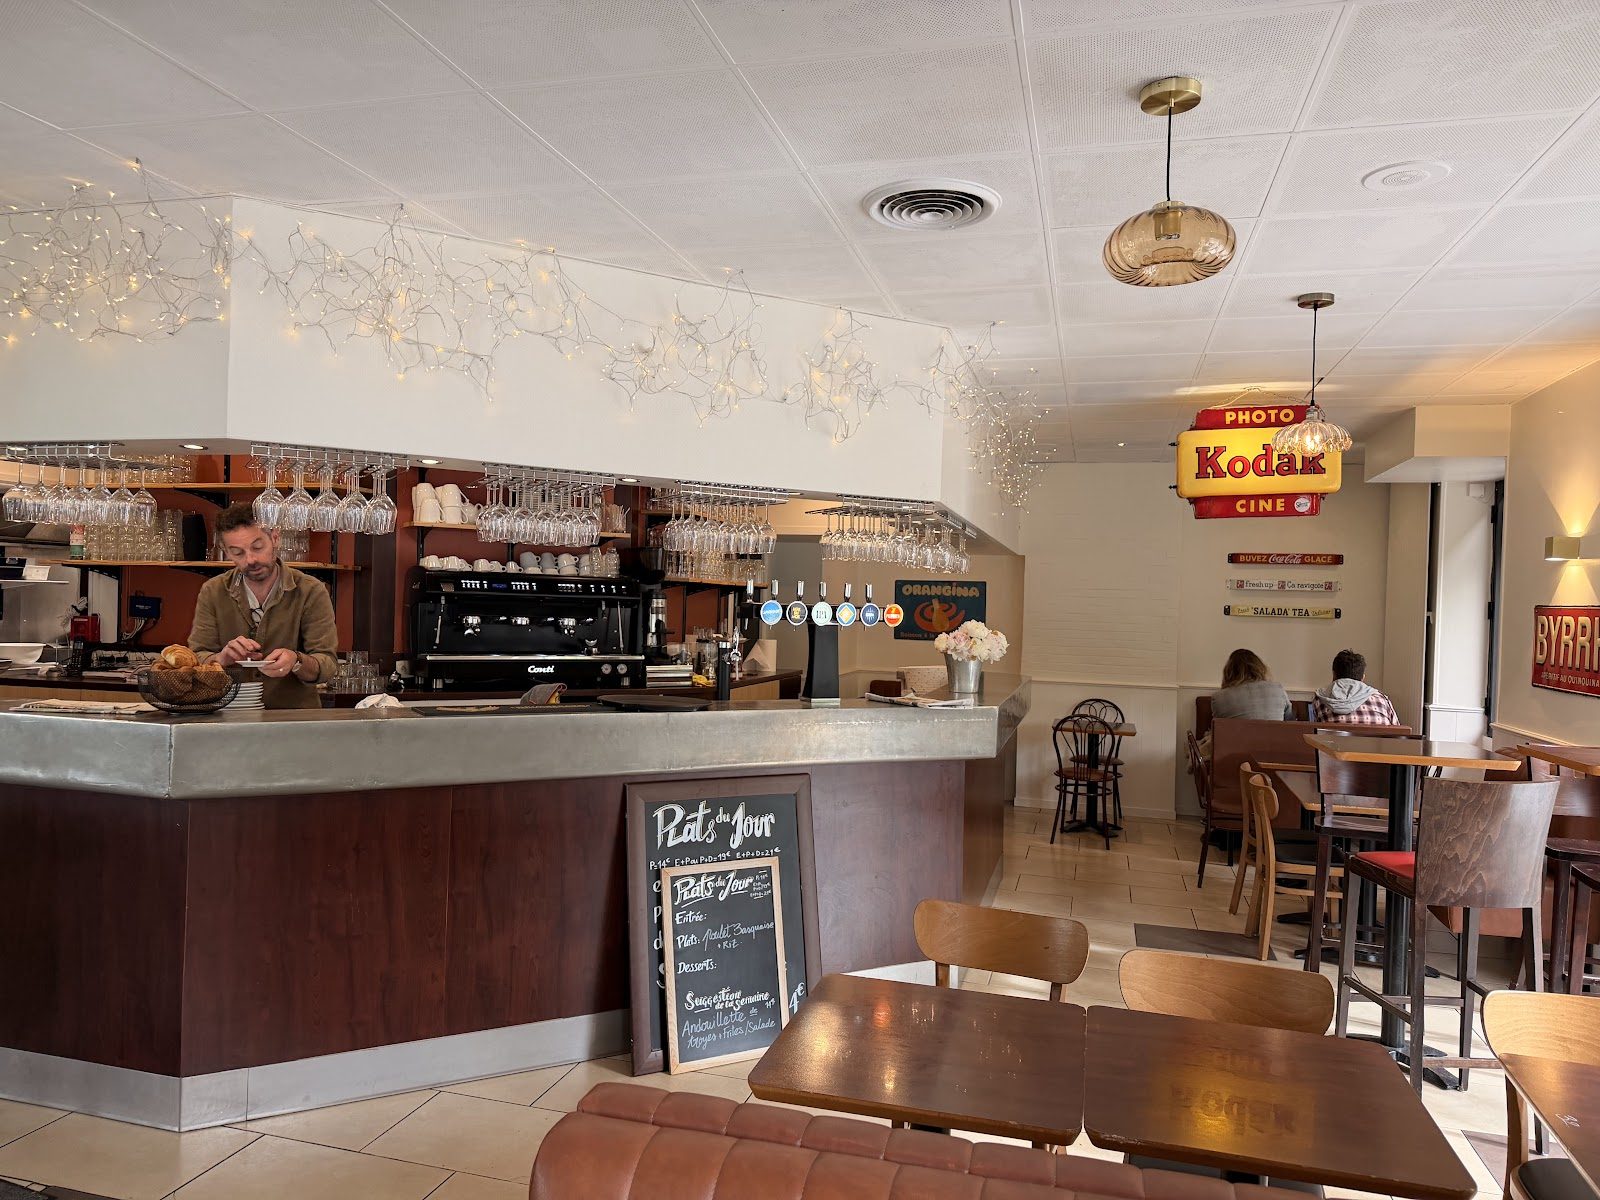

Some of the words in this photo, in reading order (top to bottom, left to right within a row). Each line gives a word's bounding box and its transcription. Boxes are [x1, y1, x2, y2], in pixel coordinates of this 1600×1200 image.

[1225, 408, 1295, 425] PHOTO
[1195, 443, 1326, 479] Kodak
[1235, 498, 1285, 513] CINE
[1239, 554, 1268, 562] BUVEZ
[1292, 608, 1310, 616] TEA
[1560, 674, 1567, 683] AU
[1567, 675, 1600, 687] QUINQUINA
[716, 807, 730, 824] du
[730, 802, 775, 849] Jour
[718, 870, 754, 901] Jour
[733, 922, 775, 939] Basquaise
[684, 986, 742, 1011] Suggestion
[715, 1002, 724, 1010] de
[682, 1011, 746, 1037] Andouillette
